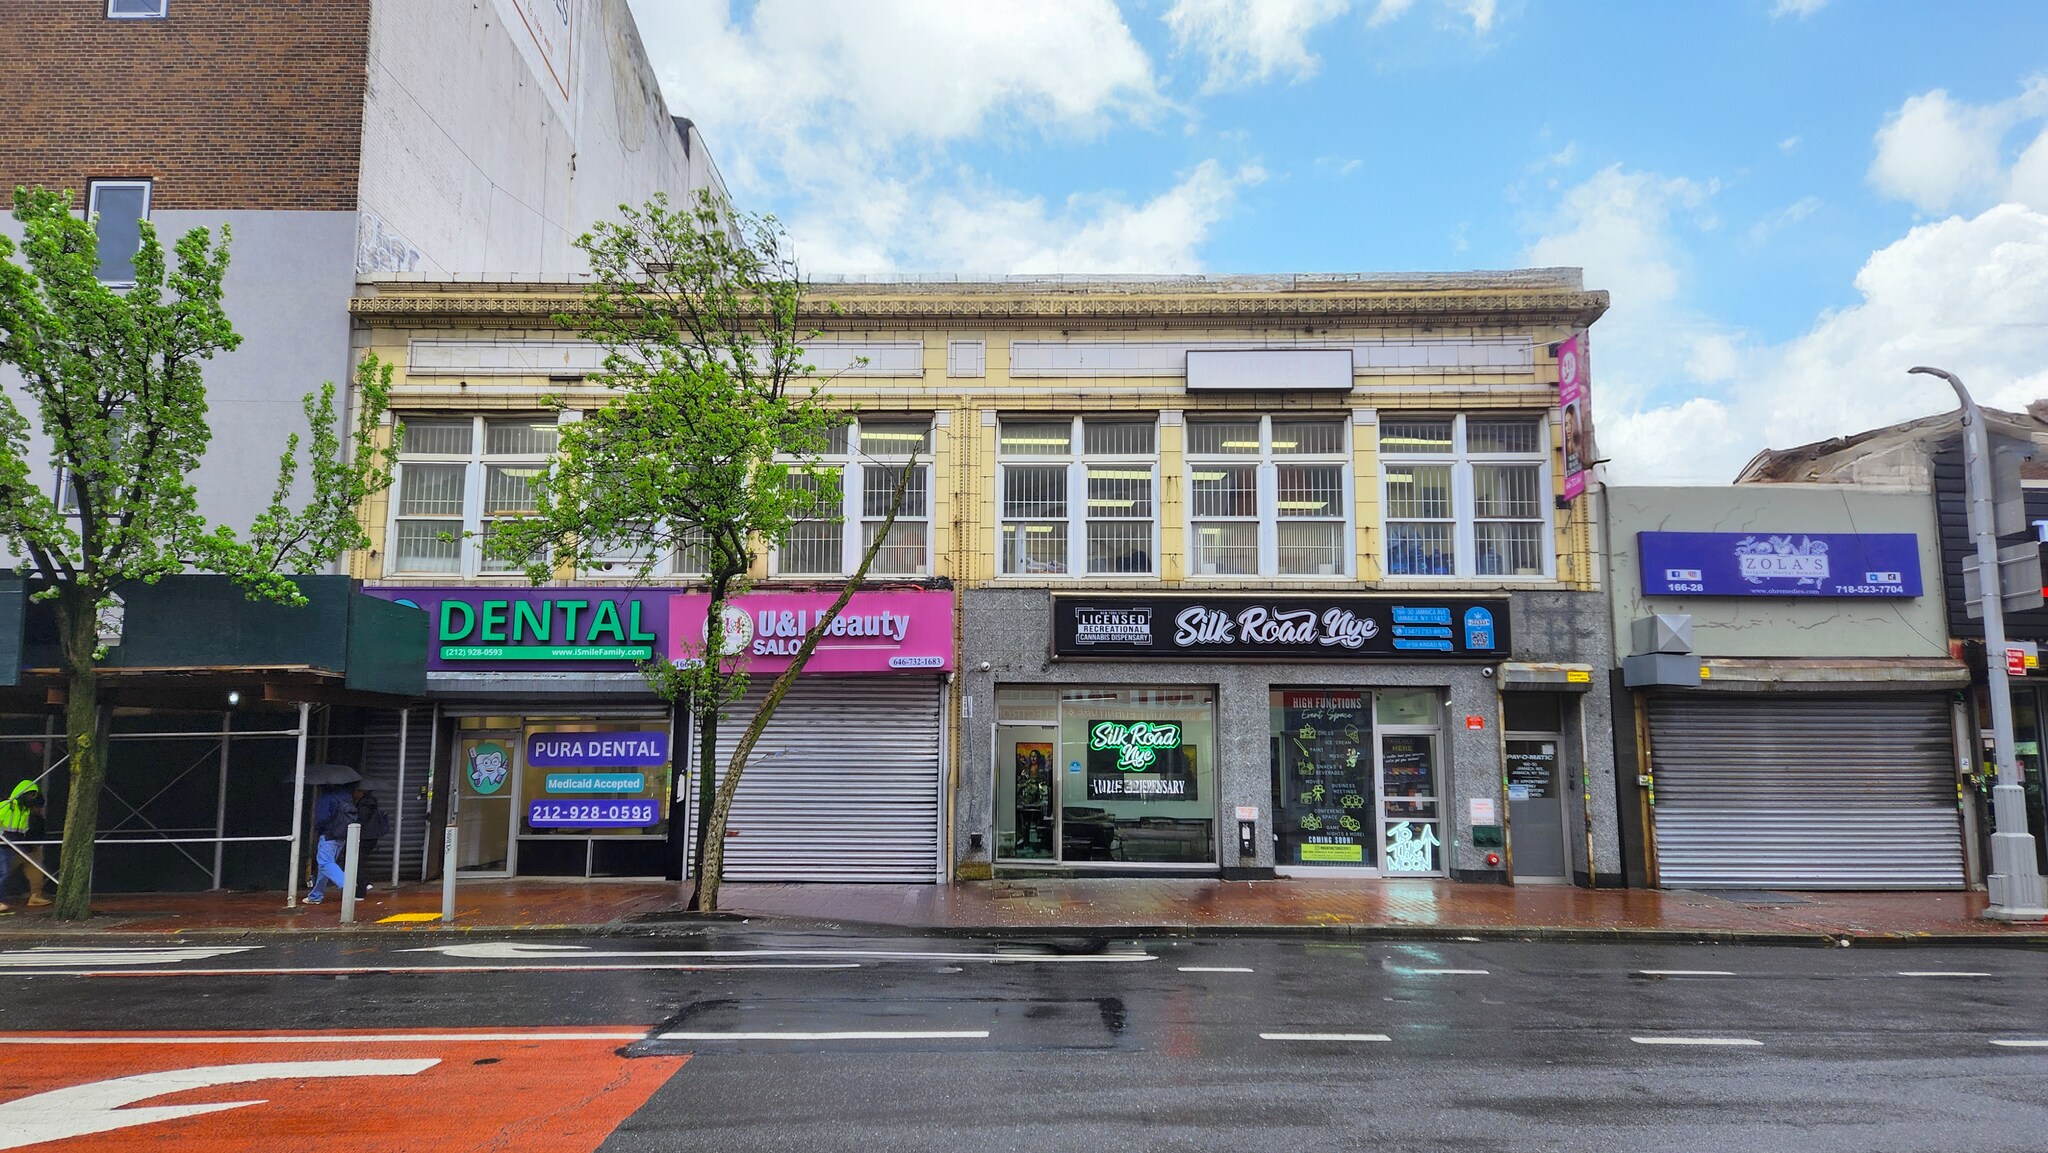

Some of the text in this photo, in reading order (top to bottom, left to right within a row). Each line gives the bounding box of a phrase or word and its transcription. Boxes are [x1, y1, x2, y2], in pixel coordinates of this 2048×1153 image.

[1746, 558, 1823, 570] ZOLA'S
[1668, 584, 1703, 592] 166-28
[1836, 585, 1903, 594] 718-523-7704
[439, 600, 656, 641] DENTAL
[758, 610, 806, 637] U&I
[1082, 614, 1145, 624] LICENSED
[1175, 606, 1378, 648] Silk Road Nyc
[446, 648, 503, 657] (212) 928-0593
[552, 648, 644, 658] www.iSmileFamily.com
[752, 639, 815, 655] SALO
[893, 658, 941, 666] 646-732-1683
[1293, 698, 1362, 708] HIGH FUNCTIONS
[1301, 708, 1354, 722] Event Space
[1094, 723, 1178, 747] Silk Road
[535, 741, 660, 757] PURA DENTAL
[1120, 745, 1153, 768] Nyc
[548, 779, 640, 790] Medicaid Accepted
[1335, 836, 1354, 844] SOON!
[1387, 856, 1432, 872] MOON
